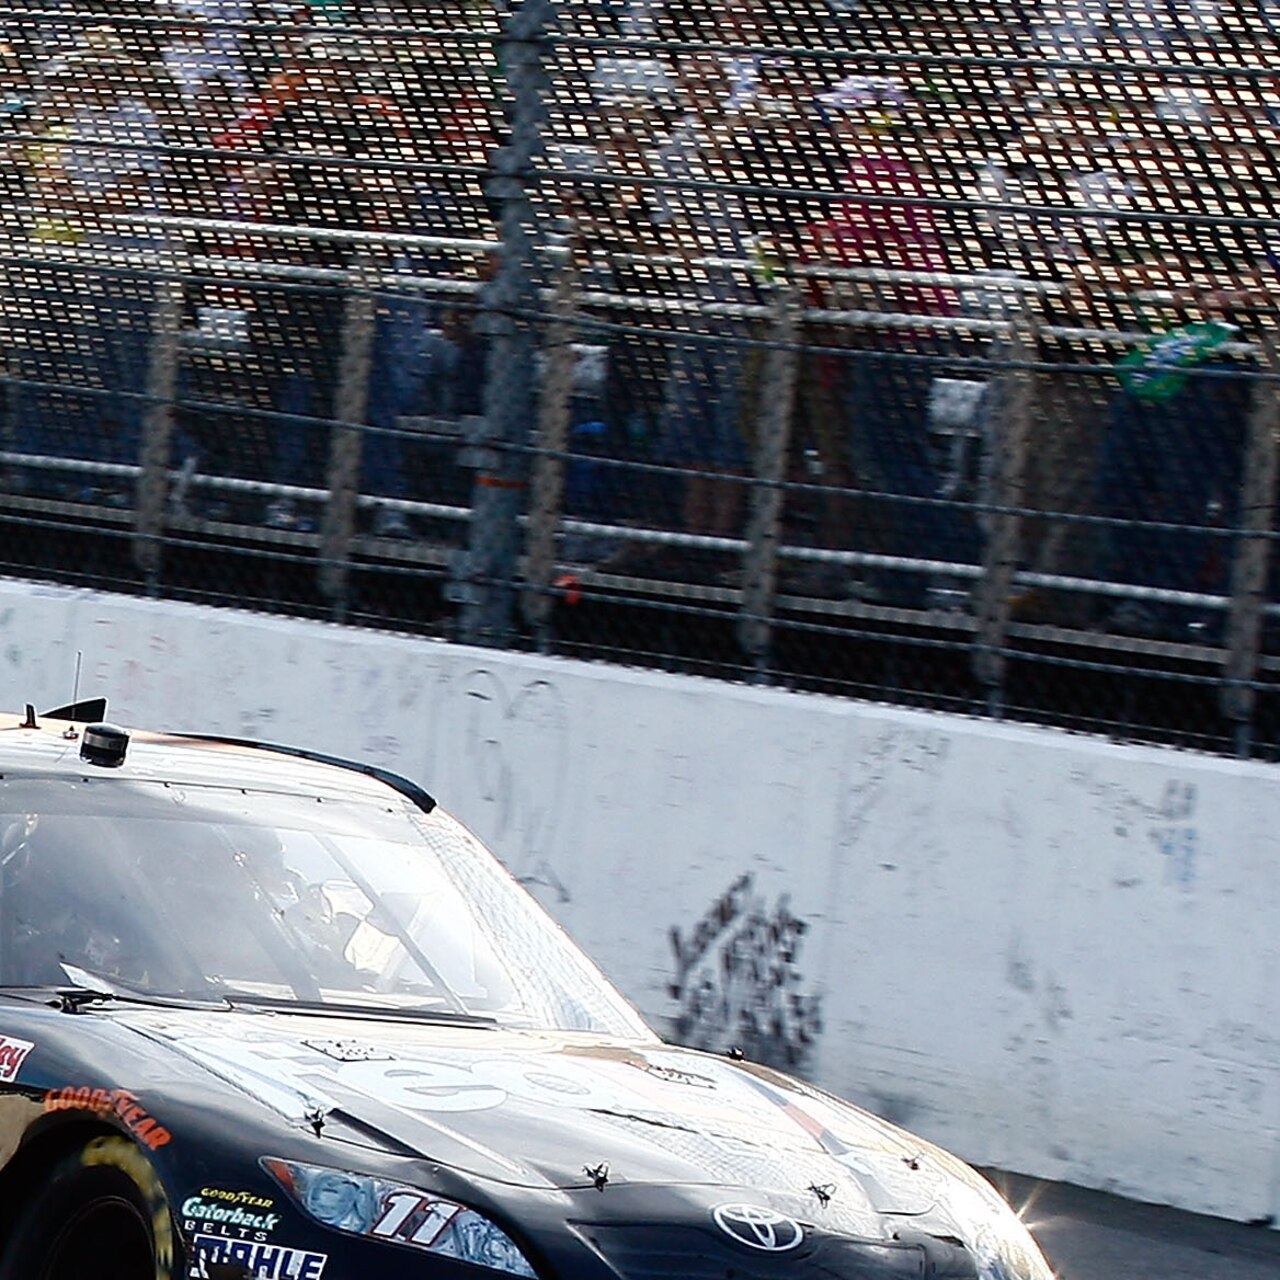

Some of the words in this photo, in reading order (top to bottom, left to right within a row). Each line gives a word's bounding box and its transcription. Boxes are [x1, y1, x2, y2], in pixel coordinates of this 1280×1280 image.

[200, 1187, 274, 1209] GOODYEAR
[181, 1196, 281, 1231] Gatorback
[370, 1191, 466, 1247] 11
[184, 1219, 268, 1243] BELTS
